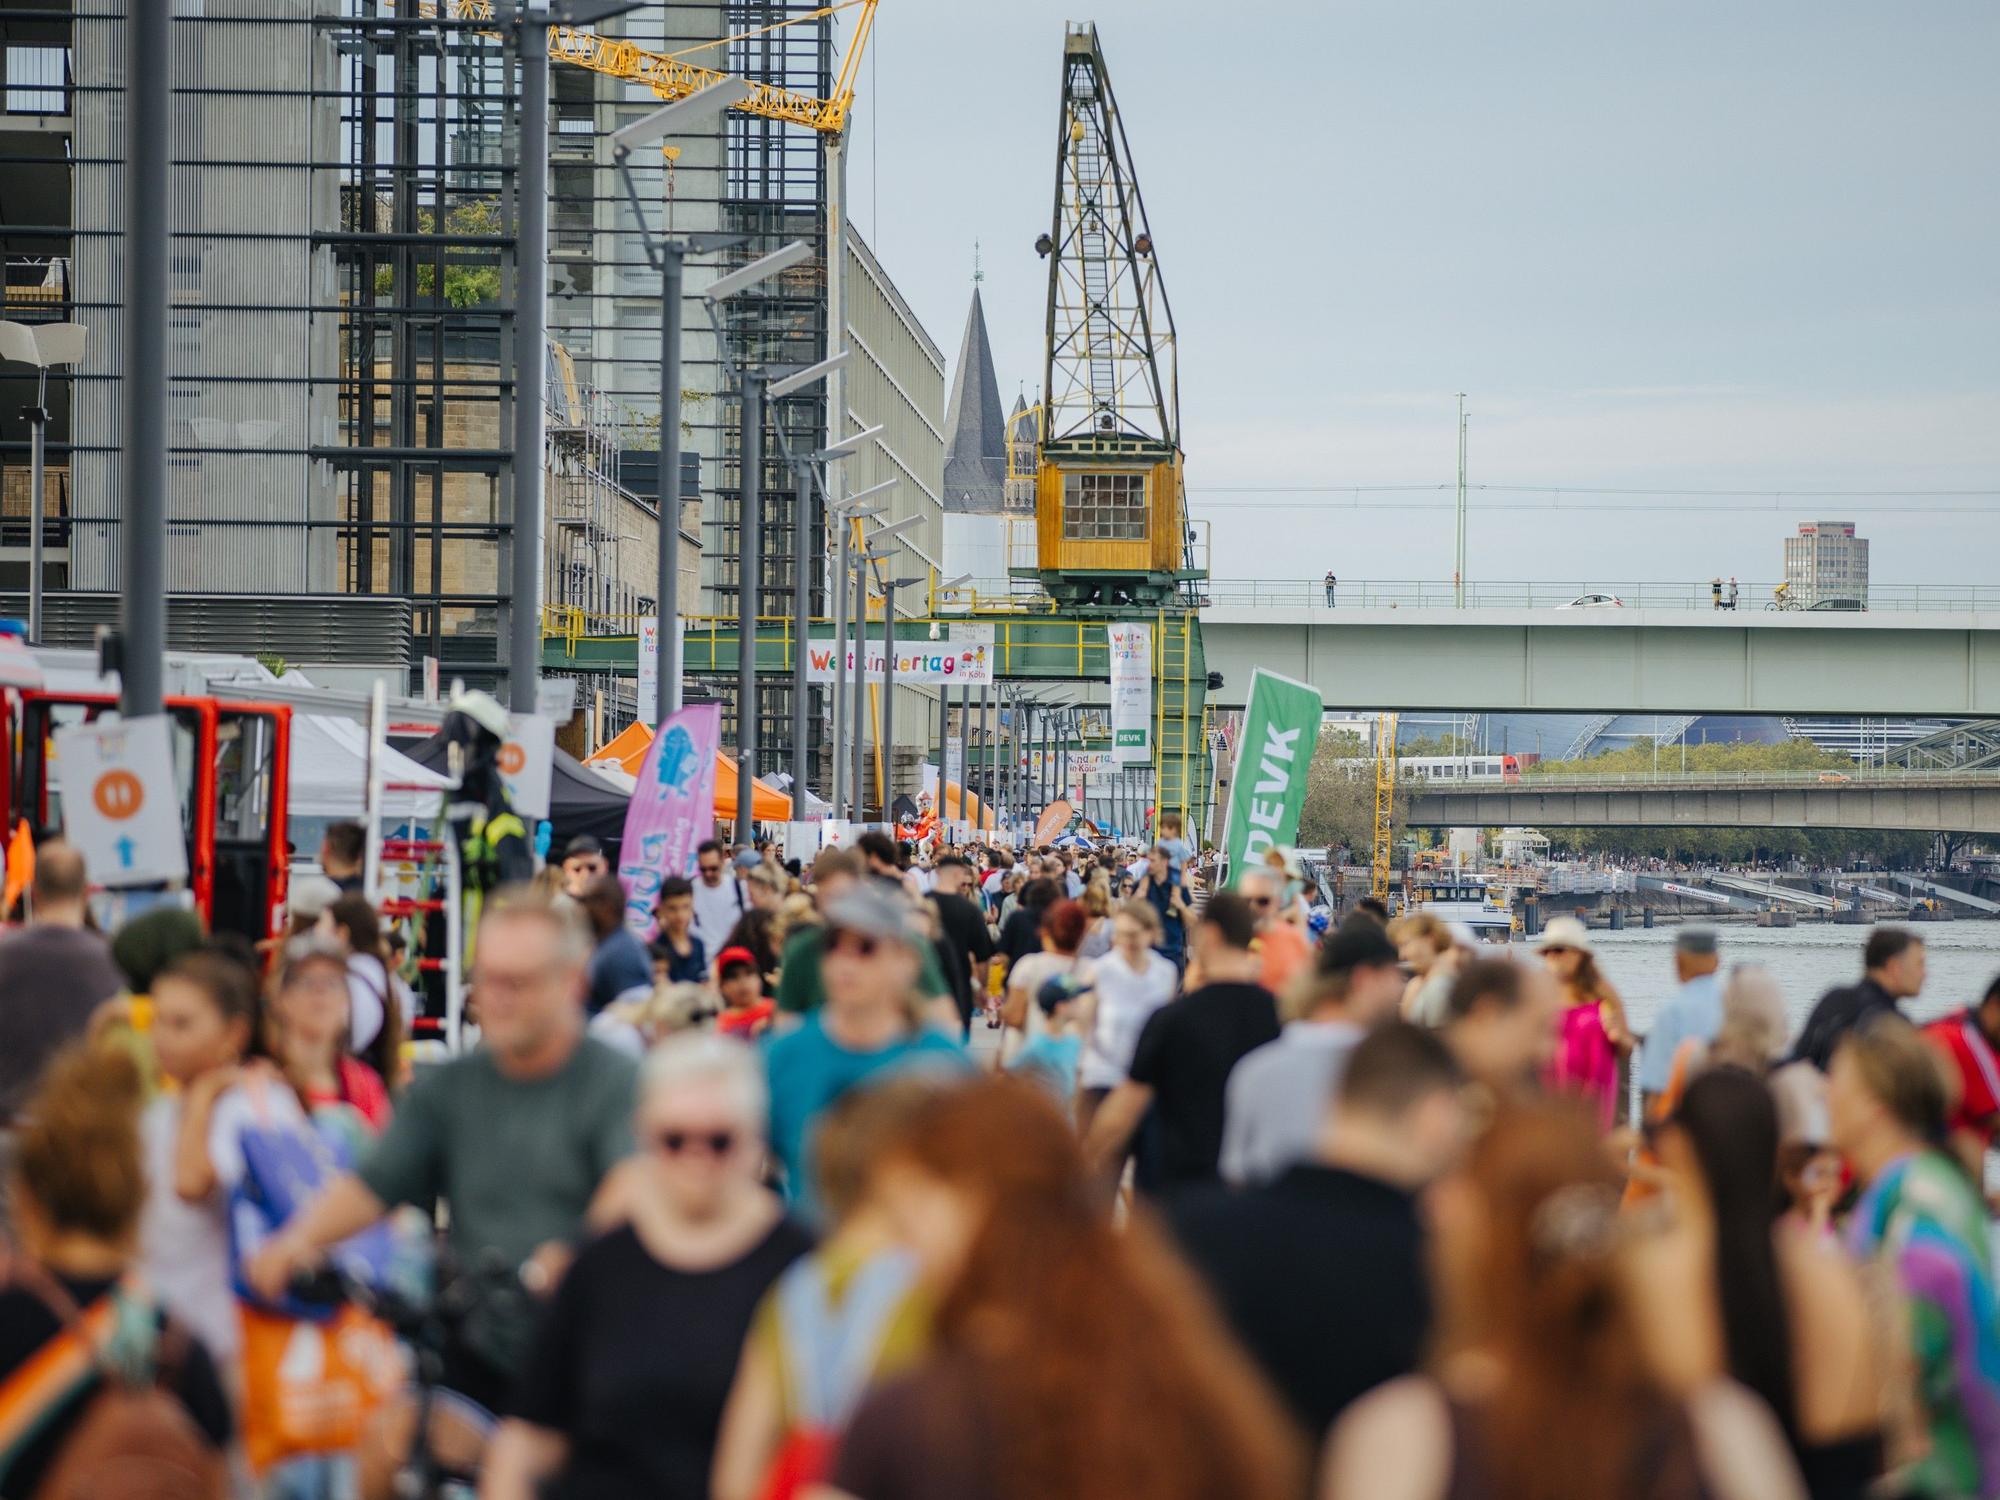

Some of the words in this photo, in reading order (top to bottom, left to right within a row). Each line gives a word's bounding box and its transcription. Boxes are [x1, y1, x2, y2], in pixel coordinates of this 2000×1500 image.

[968, 671, 986, 679] Köln
[1119, 734, 1141, 742] DEVK
[1242, 721, 1300, 866] DEVK
